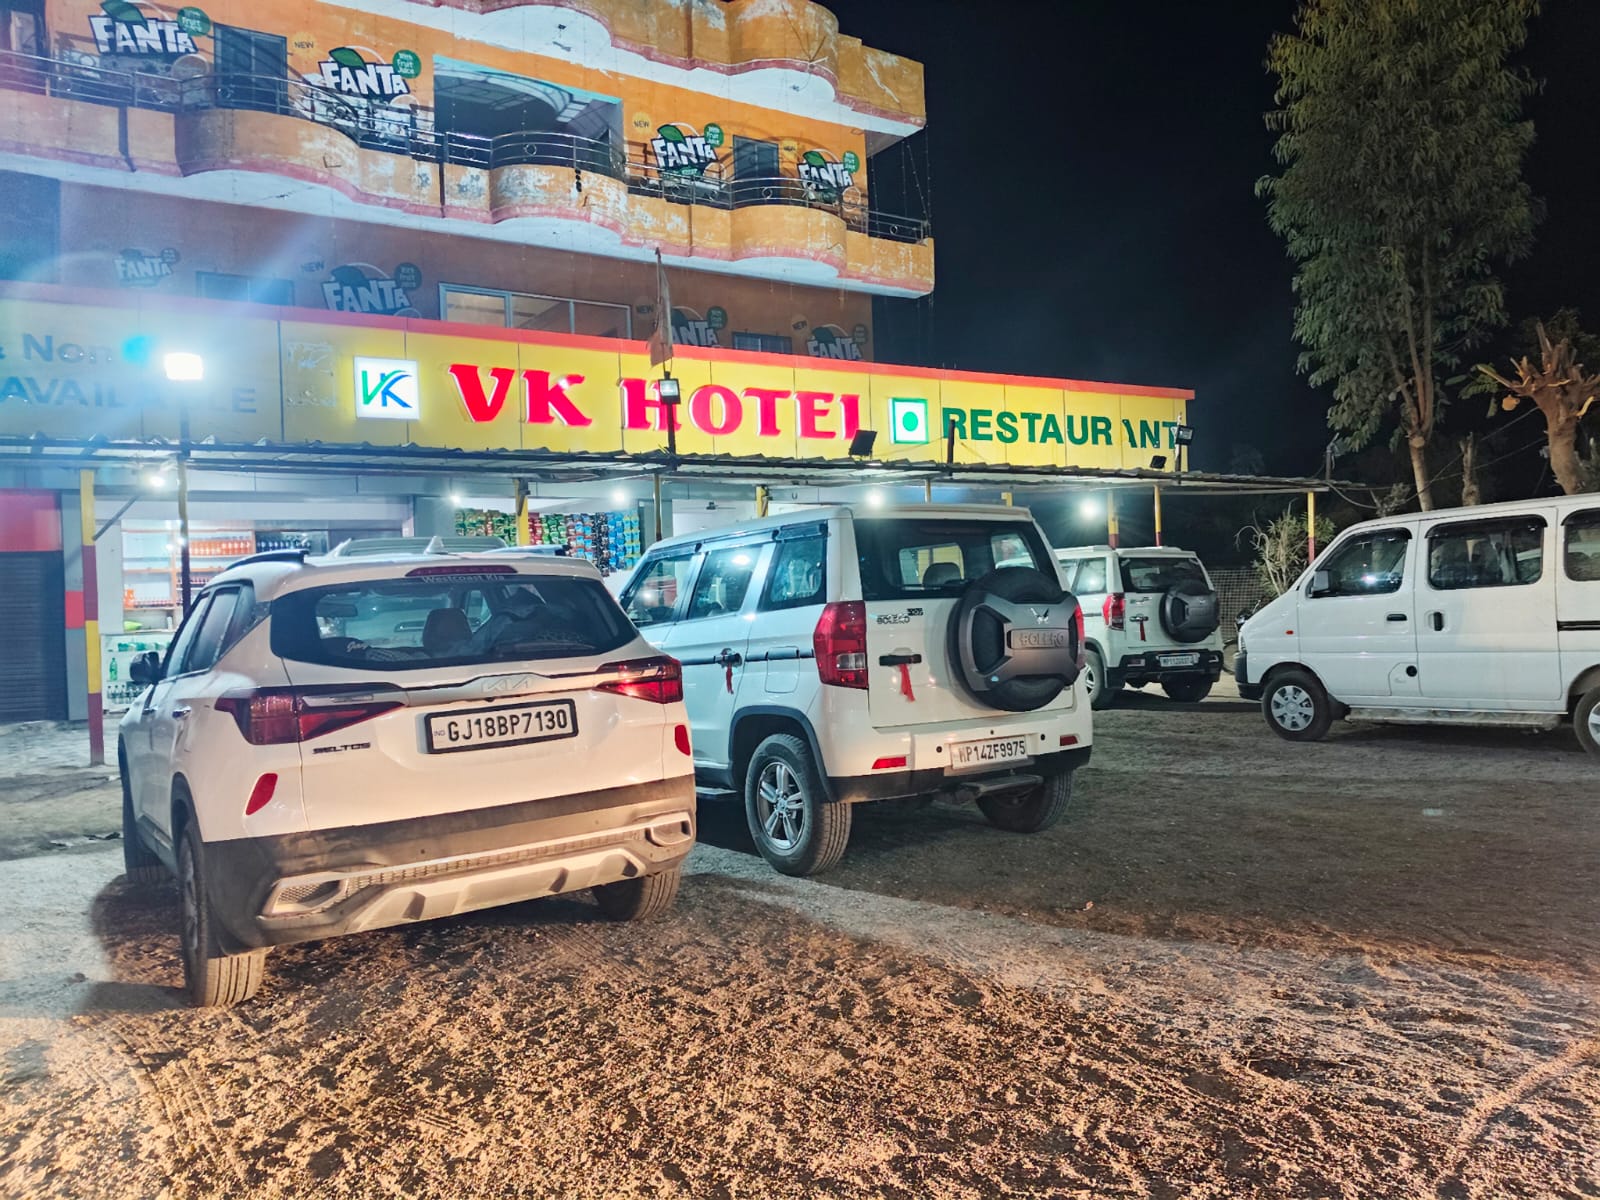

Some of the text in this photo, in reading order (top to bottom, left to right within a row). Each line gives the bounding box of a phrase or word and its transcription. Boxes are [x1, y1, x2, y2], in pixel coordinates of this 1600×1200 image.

[90, 17, 197, 52] FANTA
[320, 62, 408, 94] FANTA
[396, 58, 414, 68] Fruit
[652, 137, 717, 168] FANTA
[798, 163, 853, 189] FANTA
[114, 258, 172, 280] FANTA
[323, 280, 410, 312] FANTA
[671, 321, 718, 346] ANTA
[807, 337, 862, 360] FANTA
[0, 376, 258, 414] AVAILE
[361, 370, 412, 408] VK
[448, 363, 866, 440] VK HOTEL
[481, 675, 534, 693] KIA
[447, 709, 567, 742] GJ18BP7130
